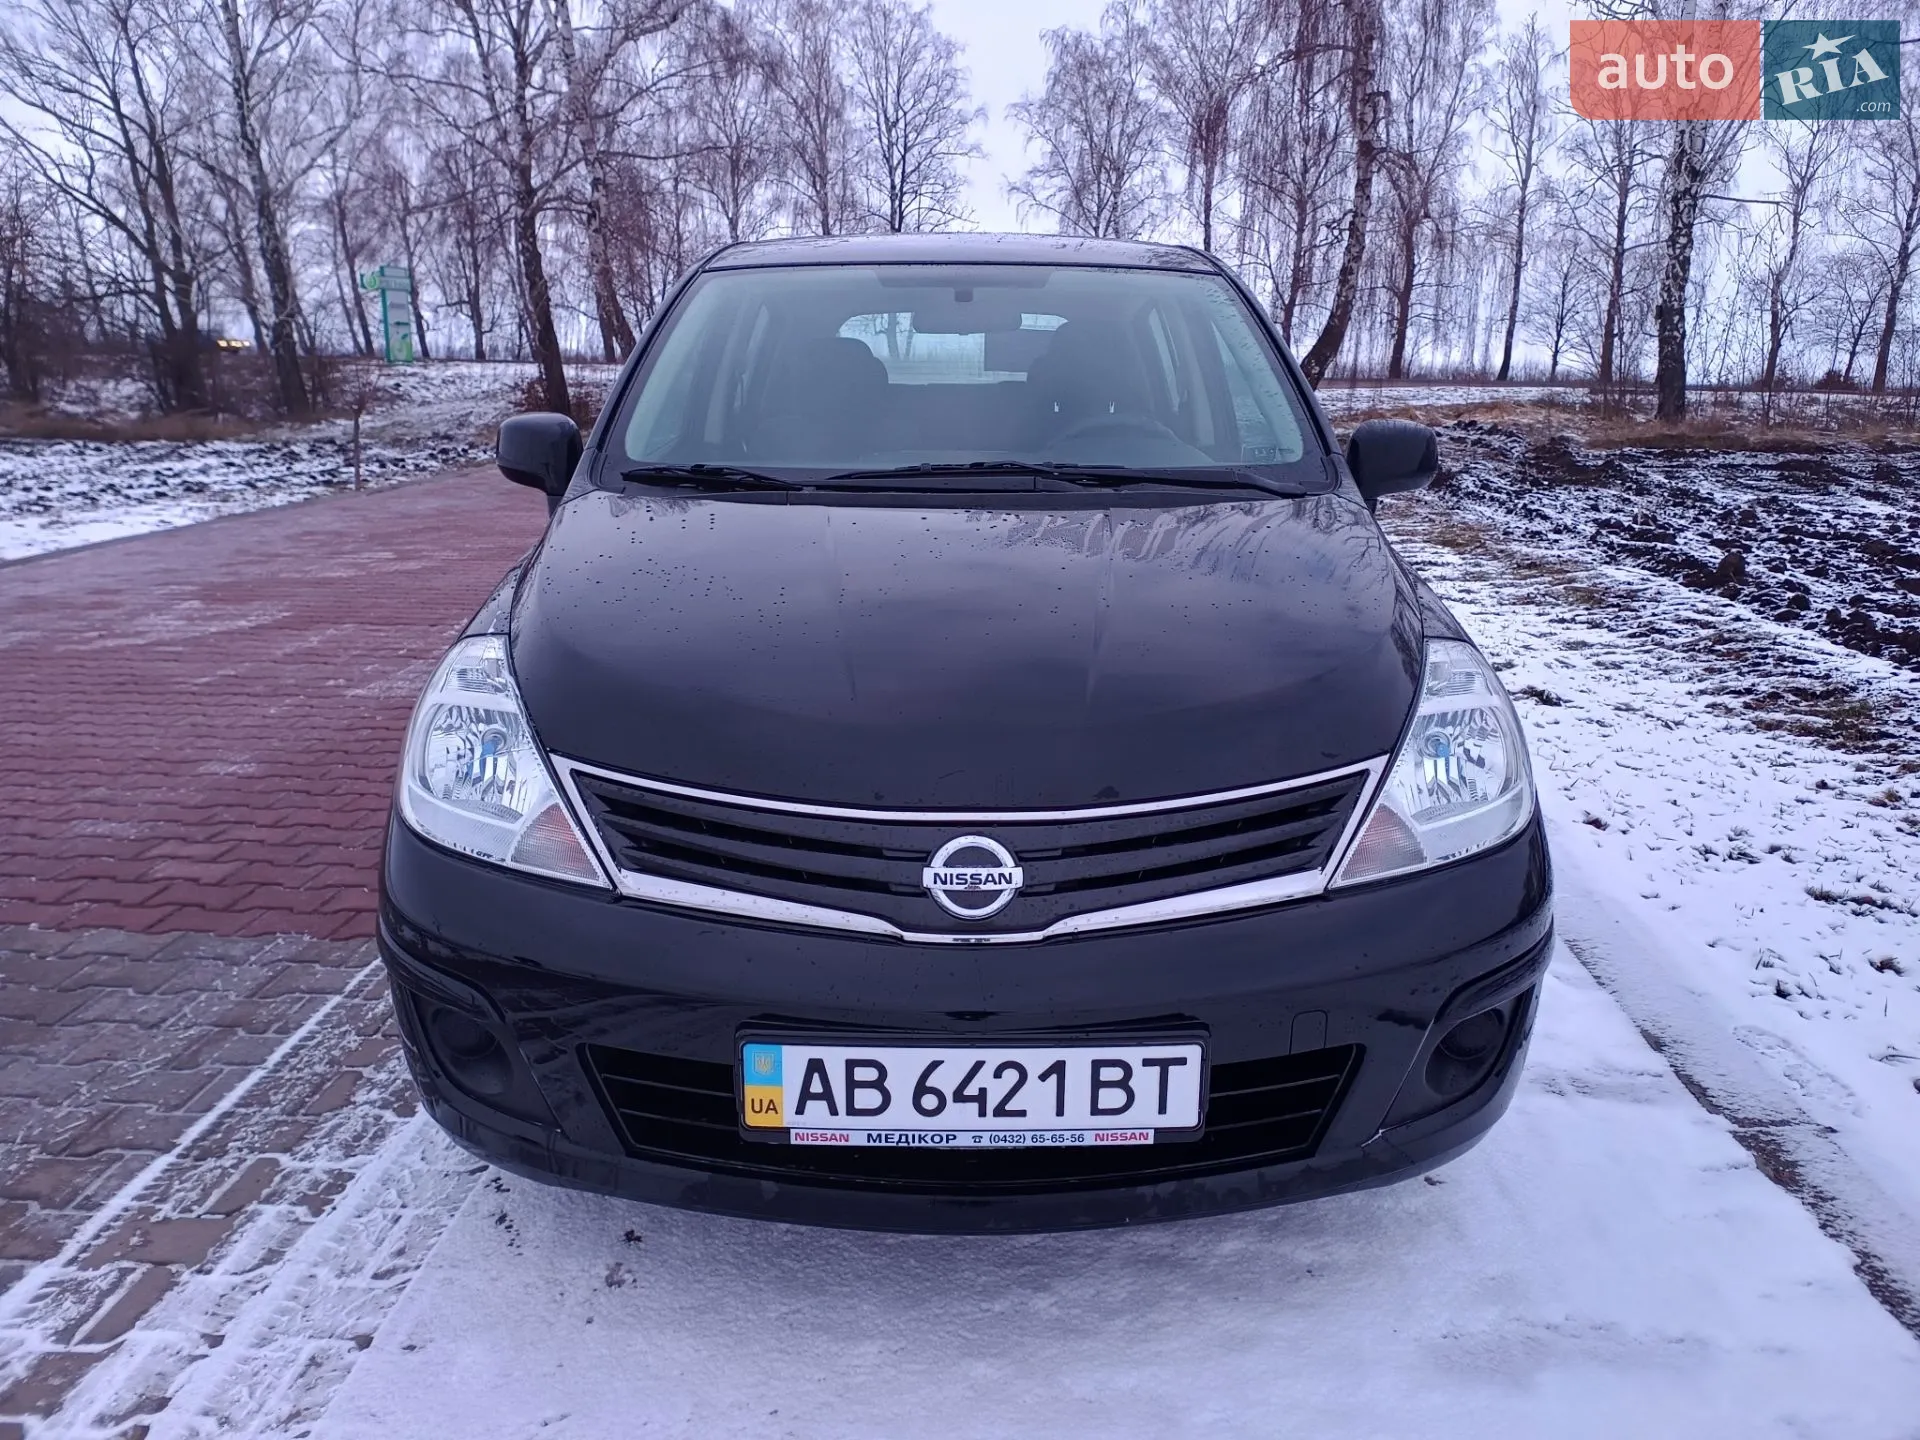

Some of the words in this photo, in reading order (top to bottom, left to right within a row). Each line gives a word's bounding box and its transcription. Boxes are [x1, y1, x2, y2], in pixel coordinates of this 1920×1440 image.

[933, 872, 1013, 886] NISSAN
[795, 1057, 892, 1117] AB
[911, 1059, 1067, 1118] 6421
[1089, 1056, 1188, 1117] BT
[750, 1098, 779, 1115] UA
[794, 1131, 850, 1143] NISSAN
[866, 1132, 958, 1146] МЕДІКОР
[989, 1133, 1026, 1145] (0432)
[1030, 1133, 1085, 1144] 65-65-56
[1094, 1131, 1150, 1143] NISSAN
